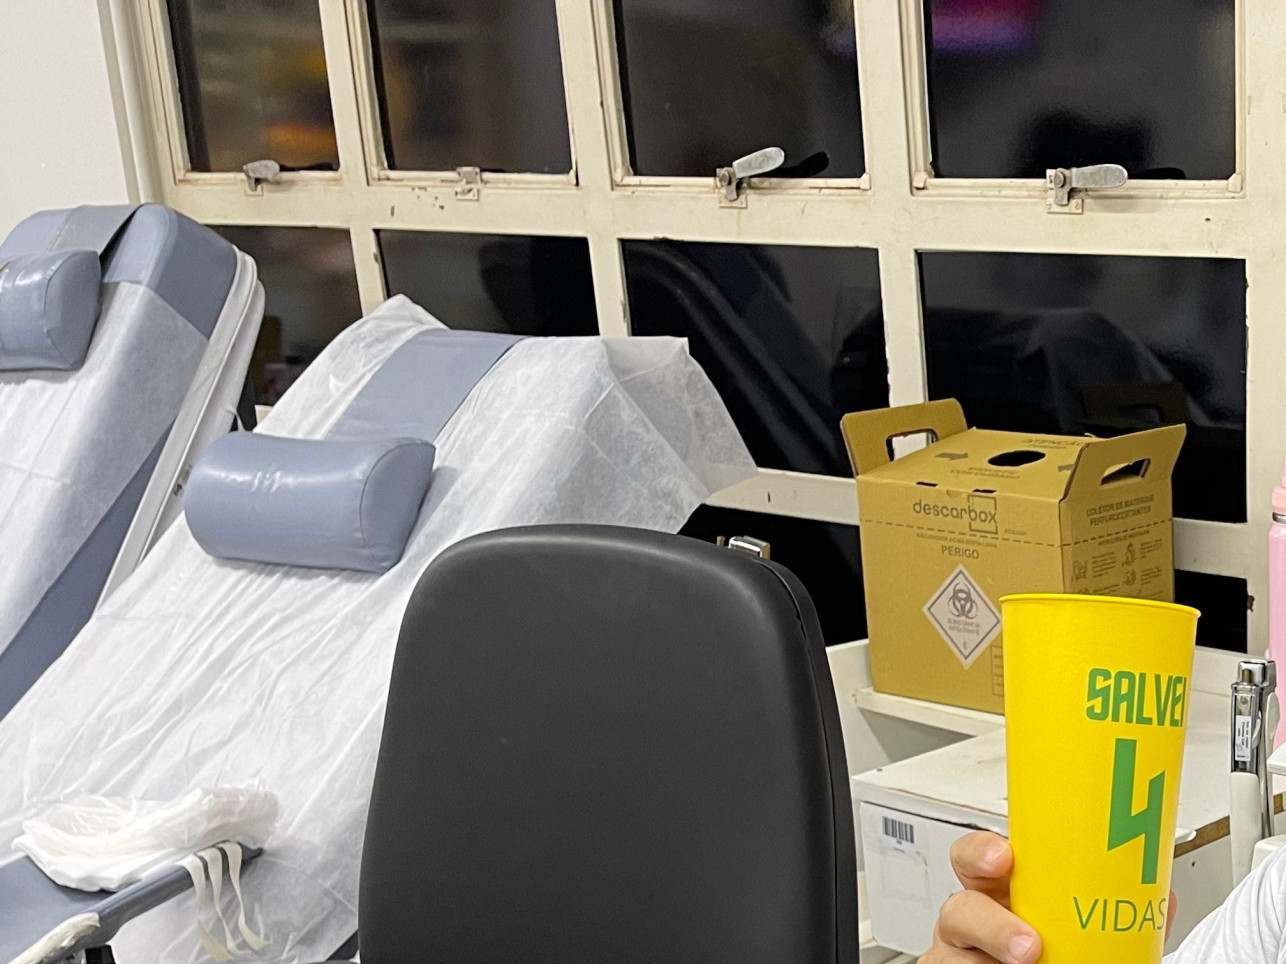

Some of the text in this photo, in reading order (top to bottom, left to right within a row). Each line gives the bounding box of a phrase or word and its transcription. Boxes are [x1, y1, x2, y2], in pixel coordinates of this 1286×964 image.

[913, 498, 998, 524] descarbox
[941, 545, 980, 560] PERIGO
[1107, 738, 1166, 885] 4
[1073, 896, 1167, 932] VIDAS
